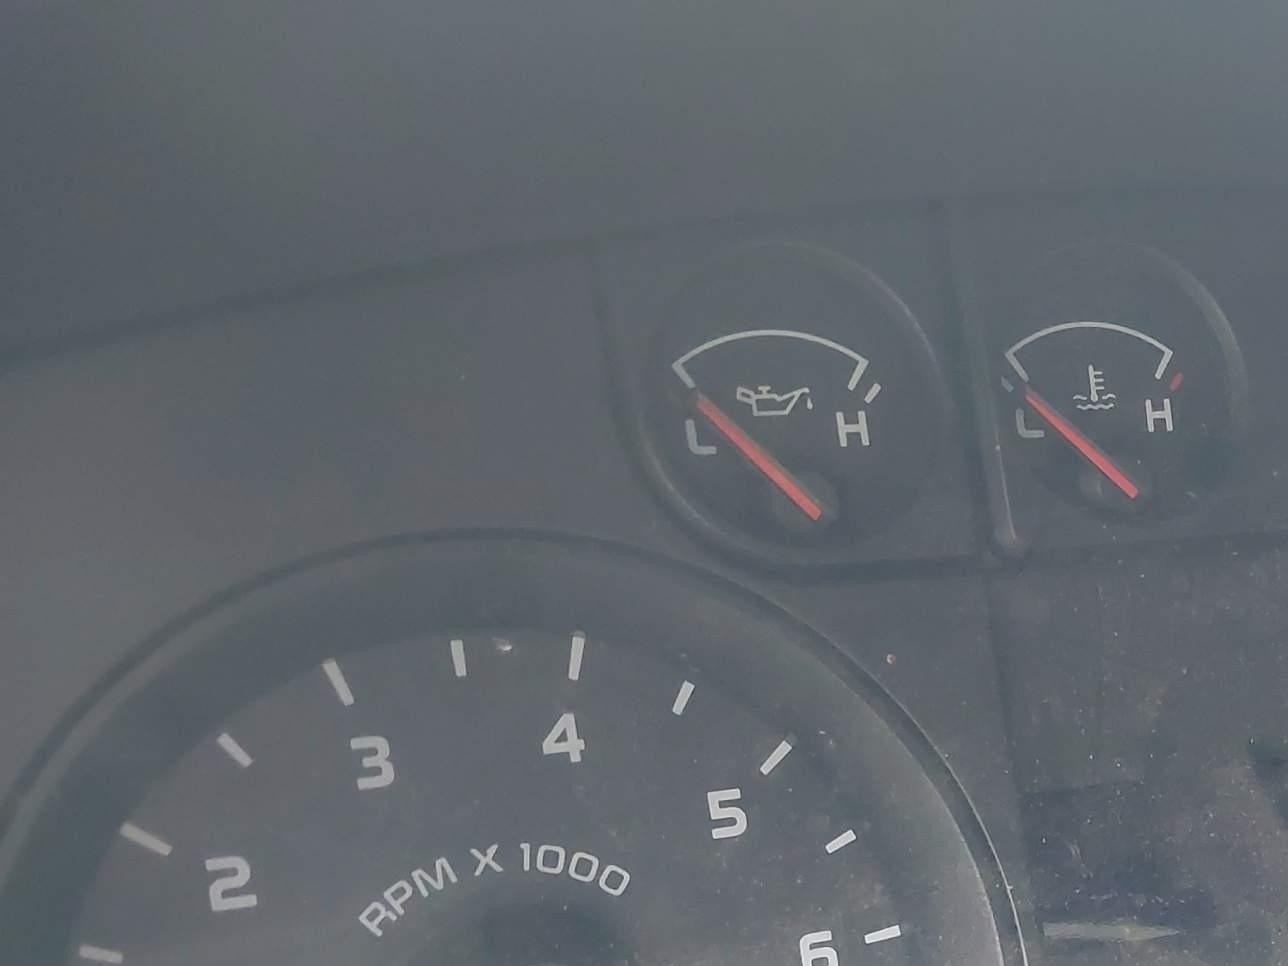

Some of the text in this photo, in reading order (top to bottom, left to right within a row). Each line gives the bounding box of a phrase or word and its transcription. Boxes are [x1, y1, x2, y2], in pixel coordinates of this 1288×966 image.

[686, 419, 717, 455] L
[836, 410, 870, 447] H
[1016, 408, 1045, 439] L
[1145, 398, 1174, 433] H
[350, 734, 396, 790] 3
[541, 714, 585, 763] 4
[707, 787, 748, 840] 5
[205, 855, 258, 913] 2
[358, 842, 631, 937] RPM X 1000
